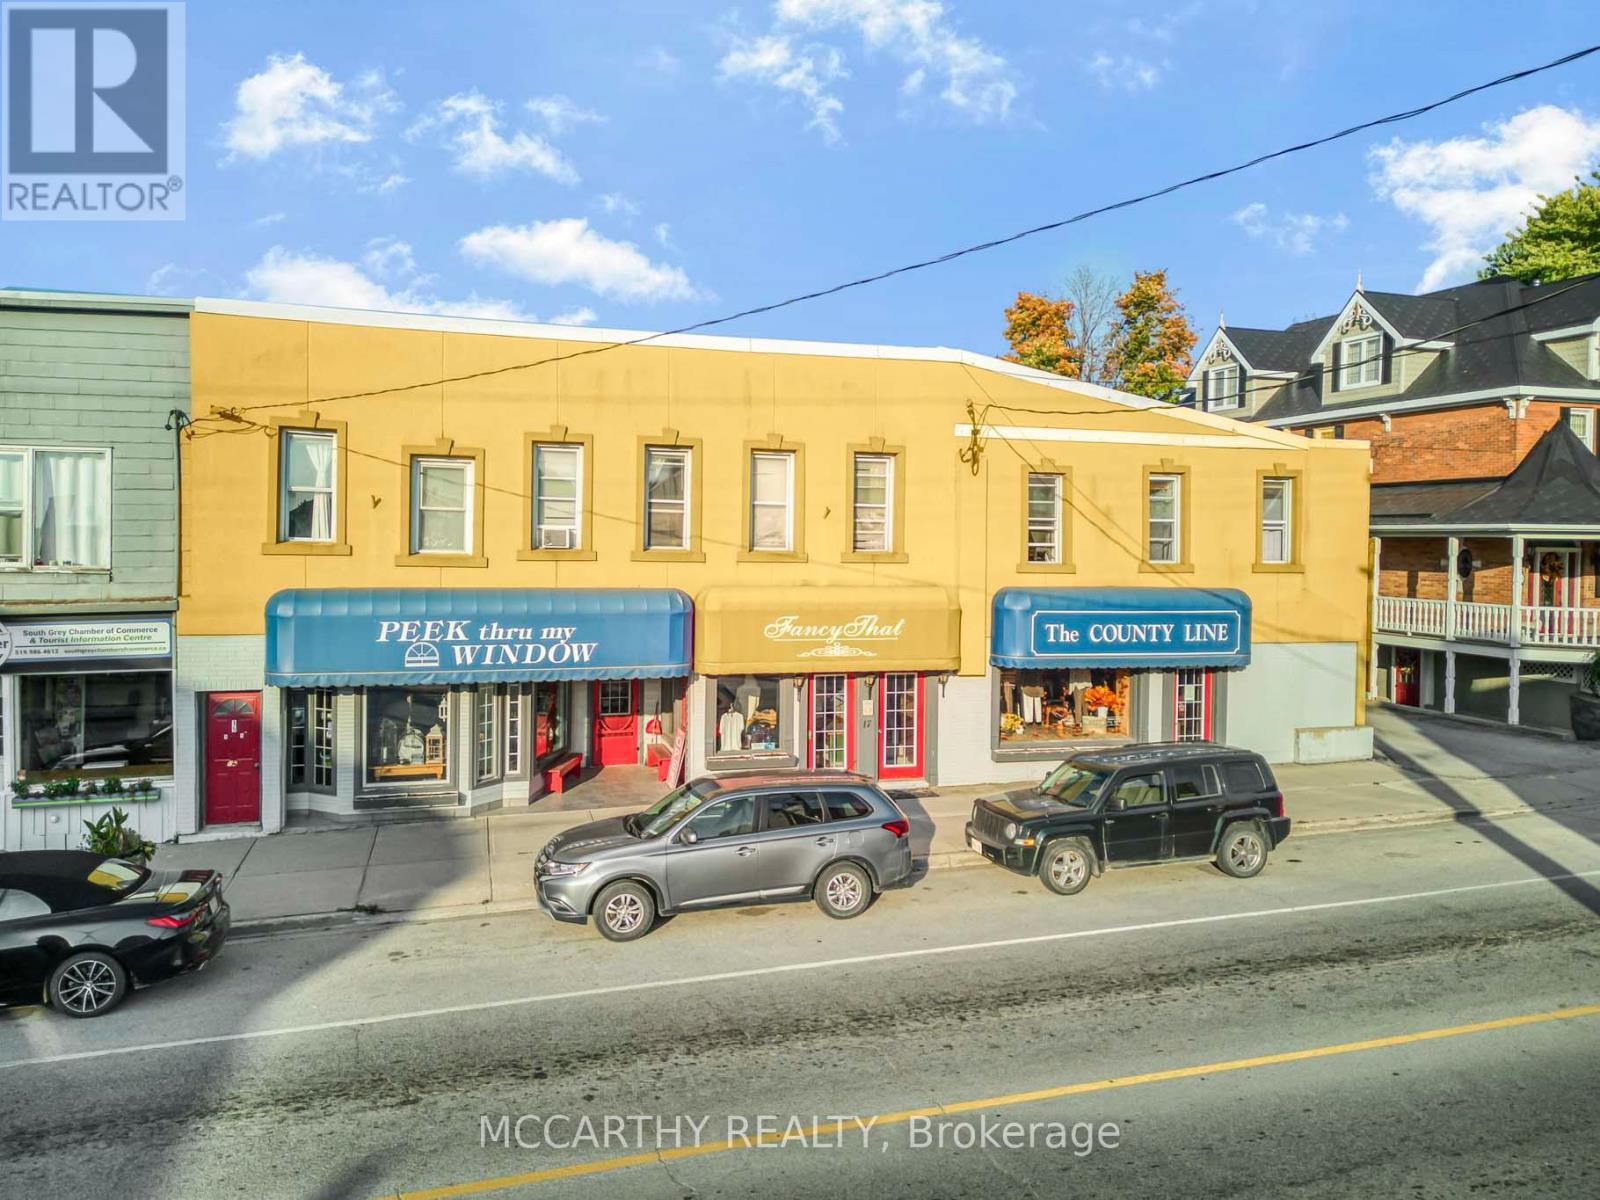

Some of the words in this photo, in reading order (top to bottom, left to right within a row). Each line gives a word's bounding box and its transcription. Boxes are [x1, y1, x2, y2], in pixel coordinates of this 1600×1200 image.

[23, 629, 47, 637] South
[48, 629, 67, 637] Grey
[69, 627, 104, 635] Chamber
[70, 635, 121, 643] Information
[376, 620, 472, 643] PEEK
[479, 622, 533, 641] thru
[540, 626, 577, 644] my
[764, 615, 844, 644] Fancy
[843, 614, 906, 637] That
[1045, 624, 1080, 643] The
[1089, 624, 1174, 643] COUNTY
[1184, 623, 1229, 642] LINE
[451, 642, 598, 665] WINDOW
[863, 719, 872, 729] 17
